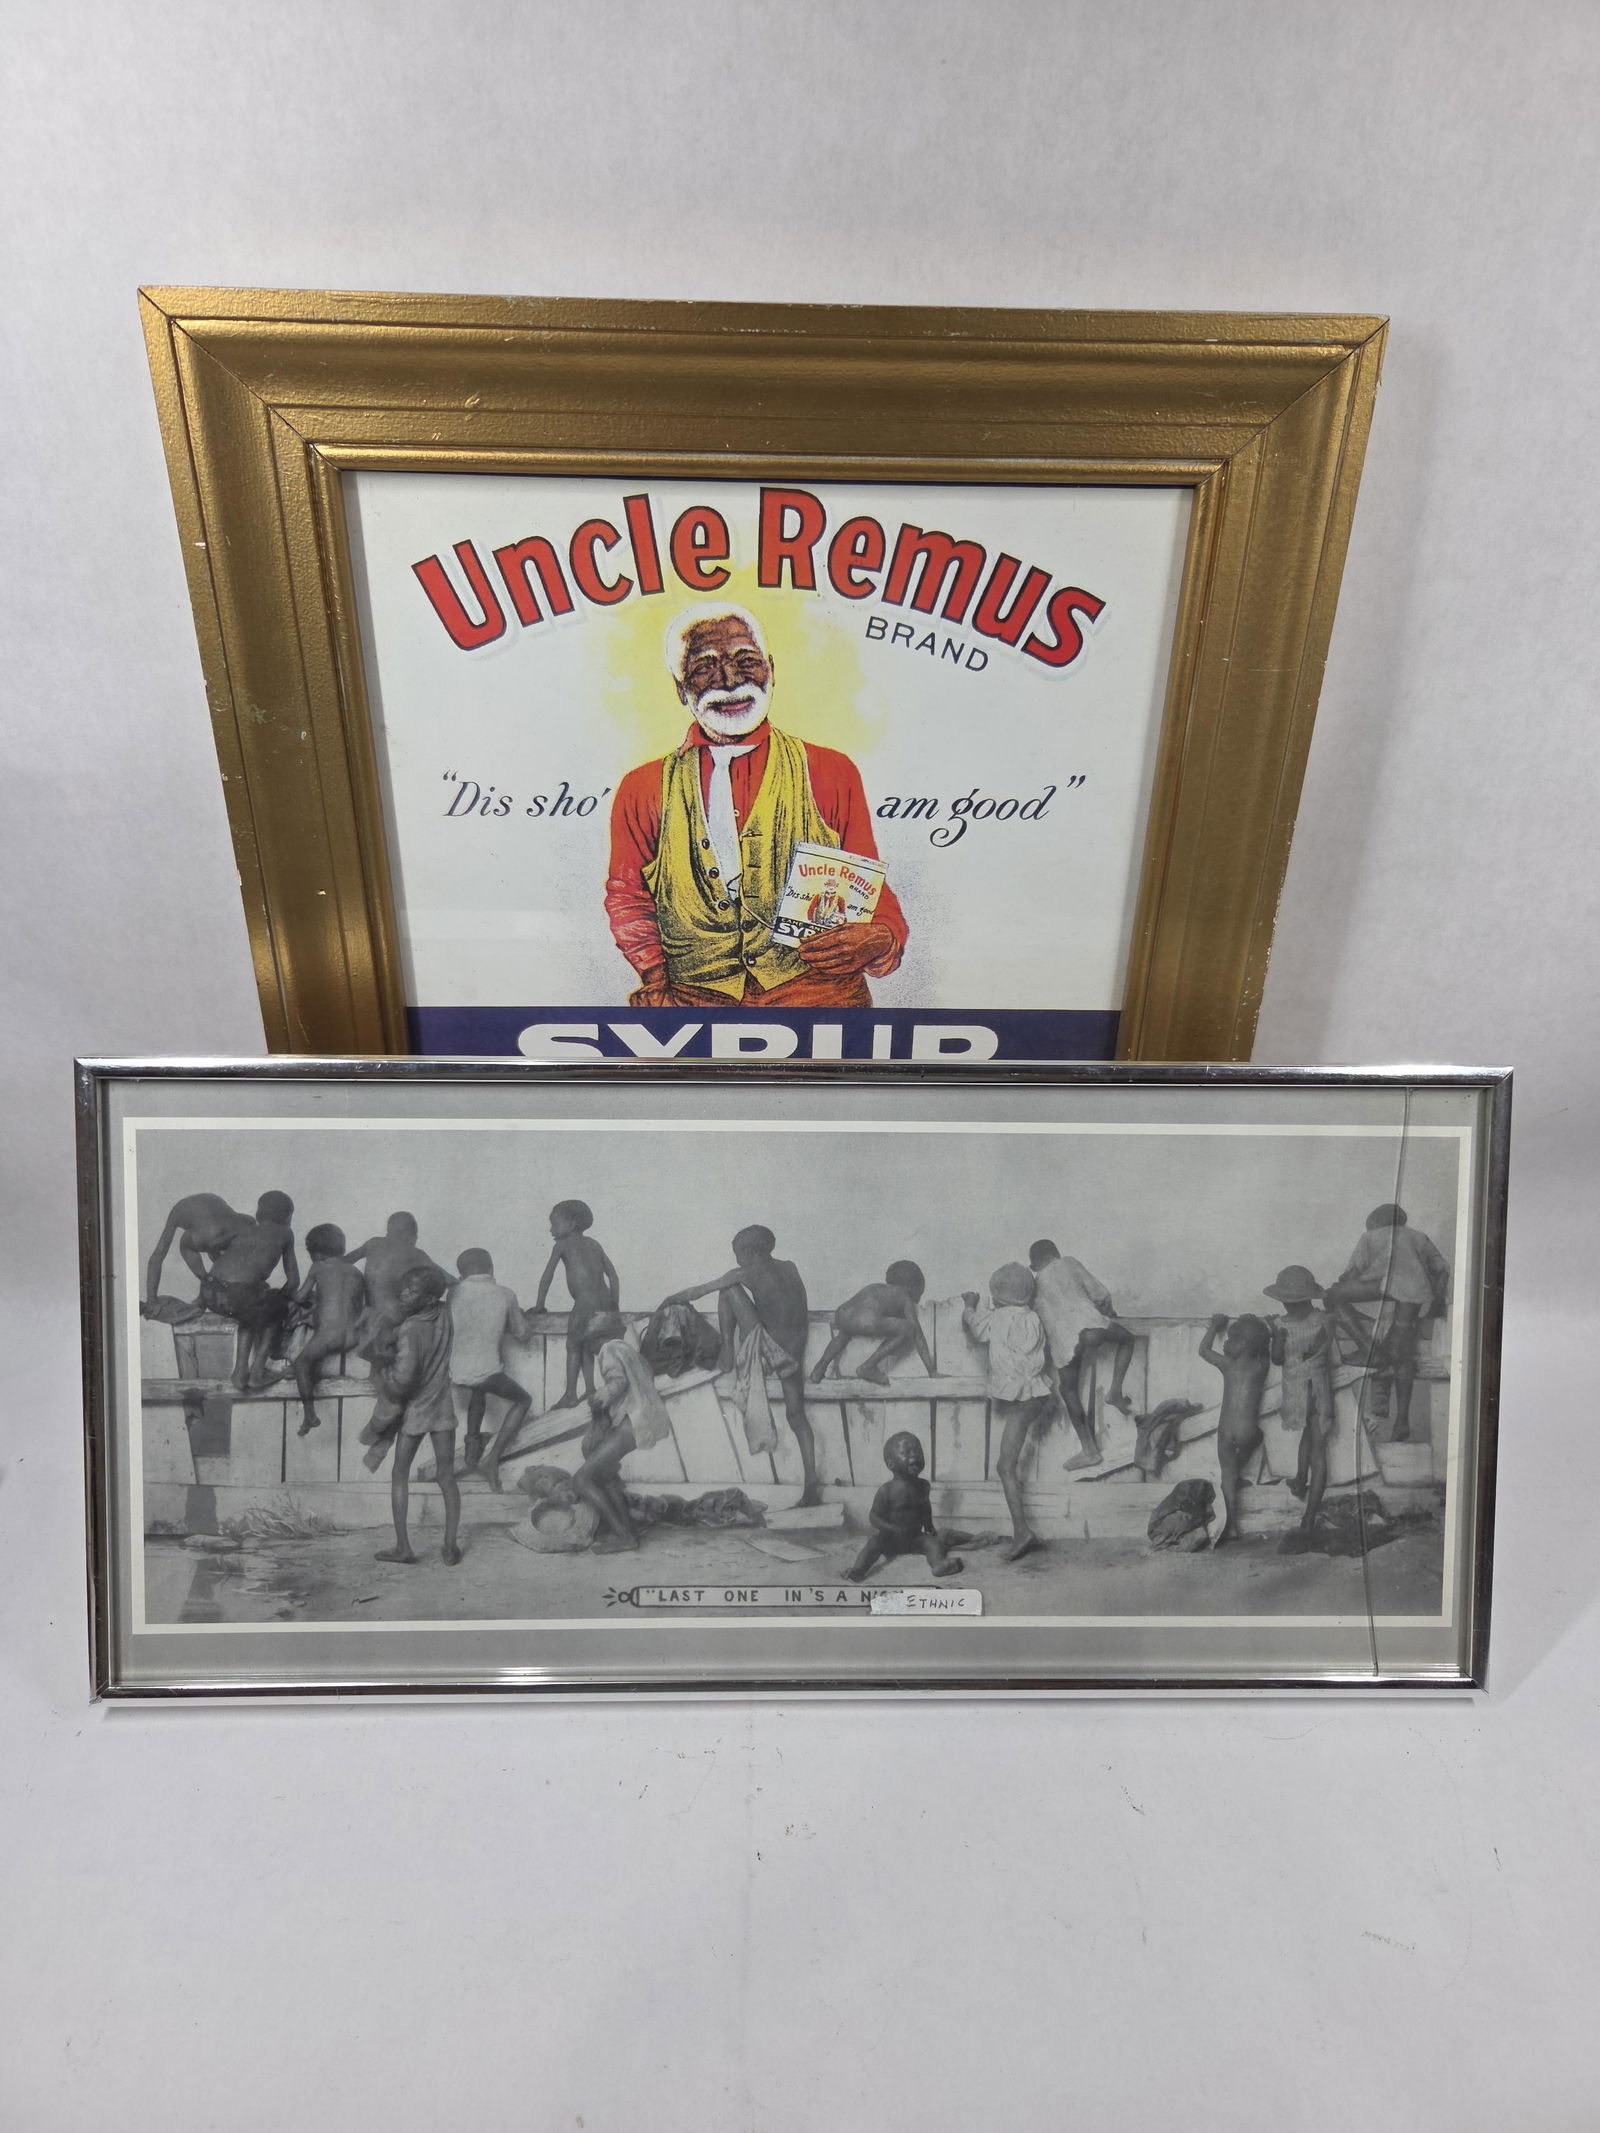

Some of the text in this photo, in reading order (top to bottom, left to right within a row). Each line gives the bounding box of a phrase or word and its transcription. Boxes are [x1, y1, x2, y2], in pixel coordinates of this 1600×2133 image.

[411, 487, 1107, 668] Uncle Remus
[865, 616, 989, 672] BRAND
[876, 796, 940, 820] am
[798, 864, 878, 896] Uncle Remus
[848, 884, 870, 900] BRAND
[724, 1589, 760, 1603] ONE
[836, 1590, 848, 1603] A
[906, 1594, 966, 1610] ETHNIC
